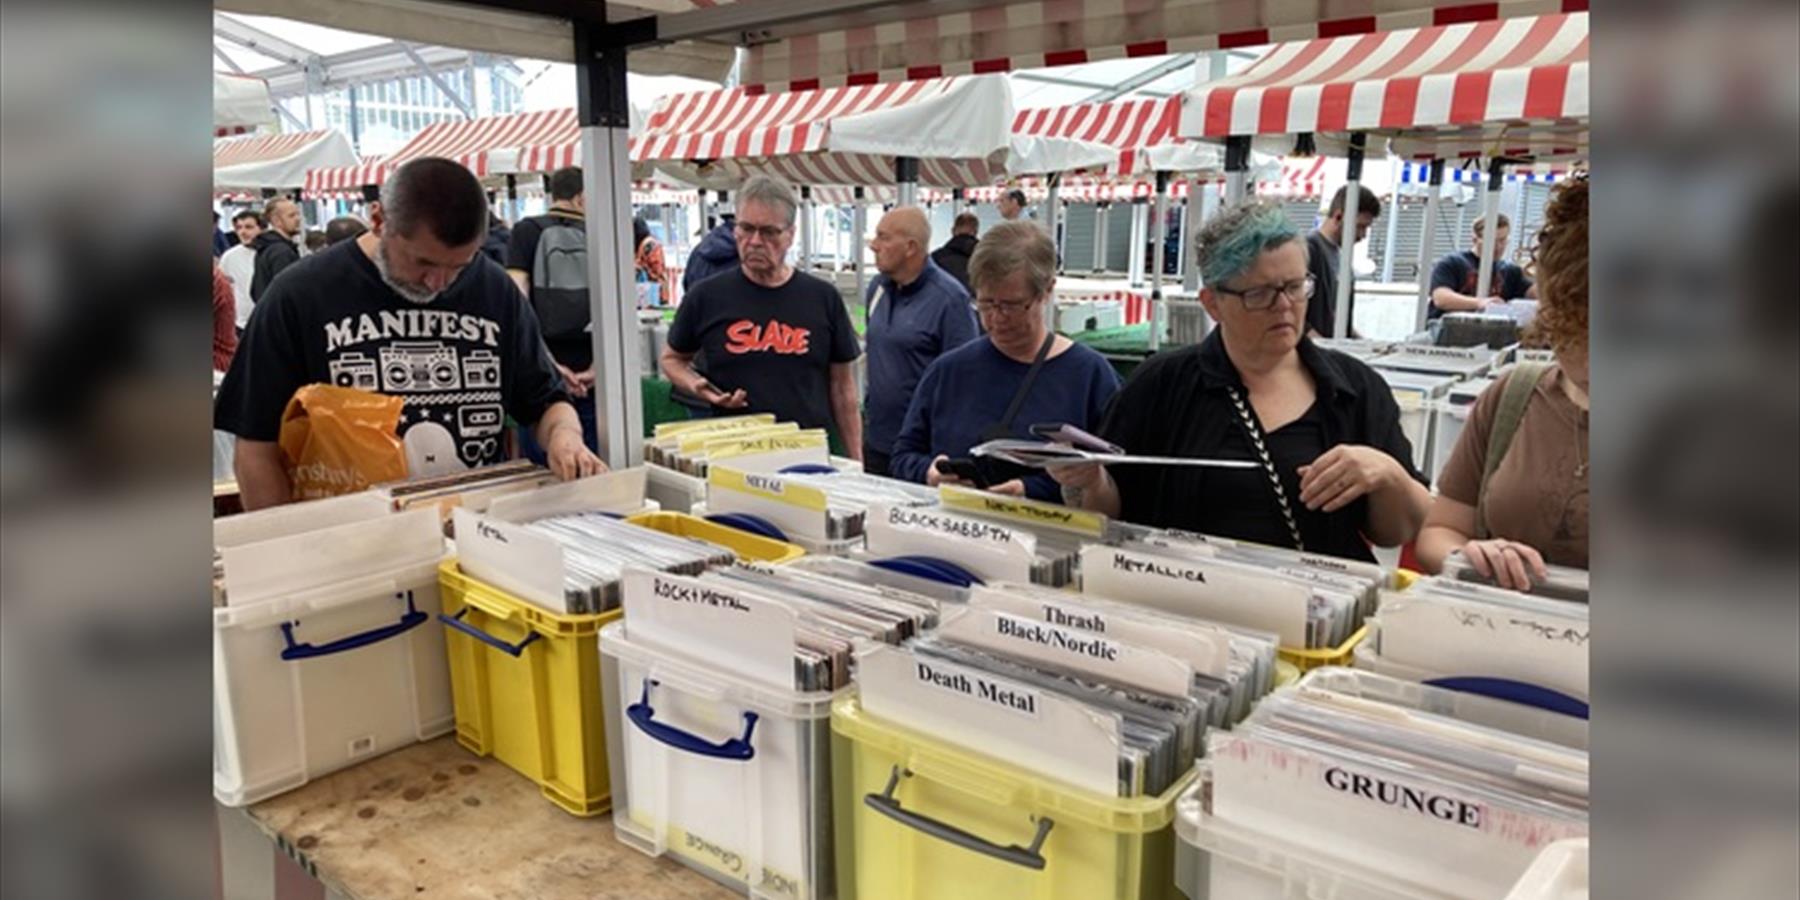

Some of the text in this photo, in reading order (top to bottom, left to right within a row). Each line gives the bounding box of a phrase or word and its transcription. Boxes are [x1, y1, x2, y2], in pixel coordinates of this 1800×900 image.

[324, 309, 501, 352] MANIFEST
[725, 319, 811, 355] SLADE
[1405, 347, 1475, 360] NEW ARRIVALS
[745, 474, 784, 492] METAL
[888, 506, 1011, 543] BLACK SABBATH
[984, 498, 1073, 523] NEW TODAY
[1113, 553, 1207, 584] METALLICA
[1042, 604, 1106, 633] Thrash
[997, 616, 1118, 661] Black/Nordic
[917, 662, 1035, 714] Death Metal
[1324, 766, 1482, 829] GRUNGE
